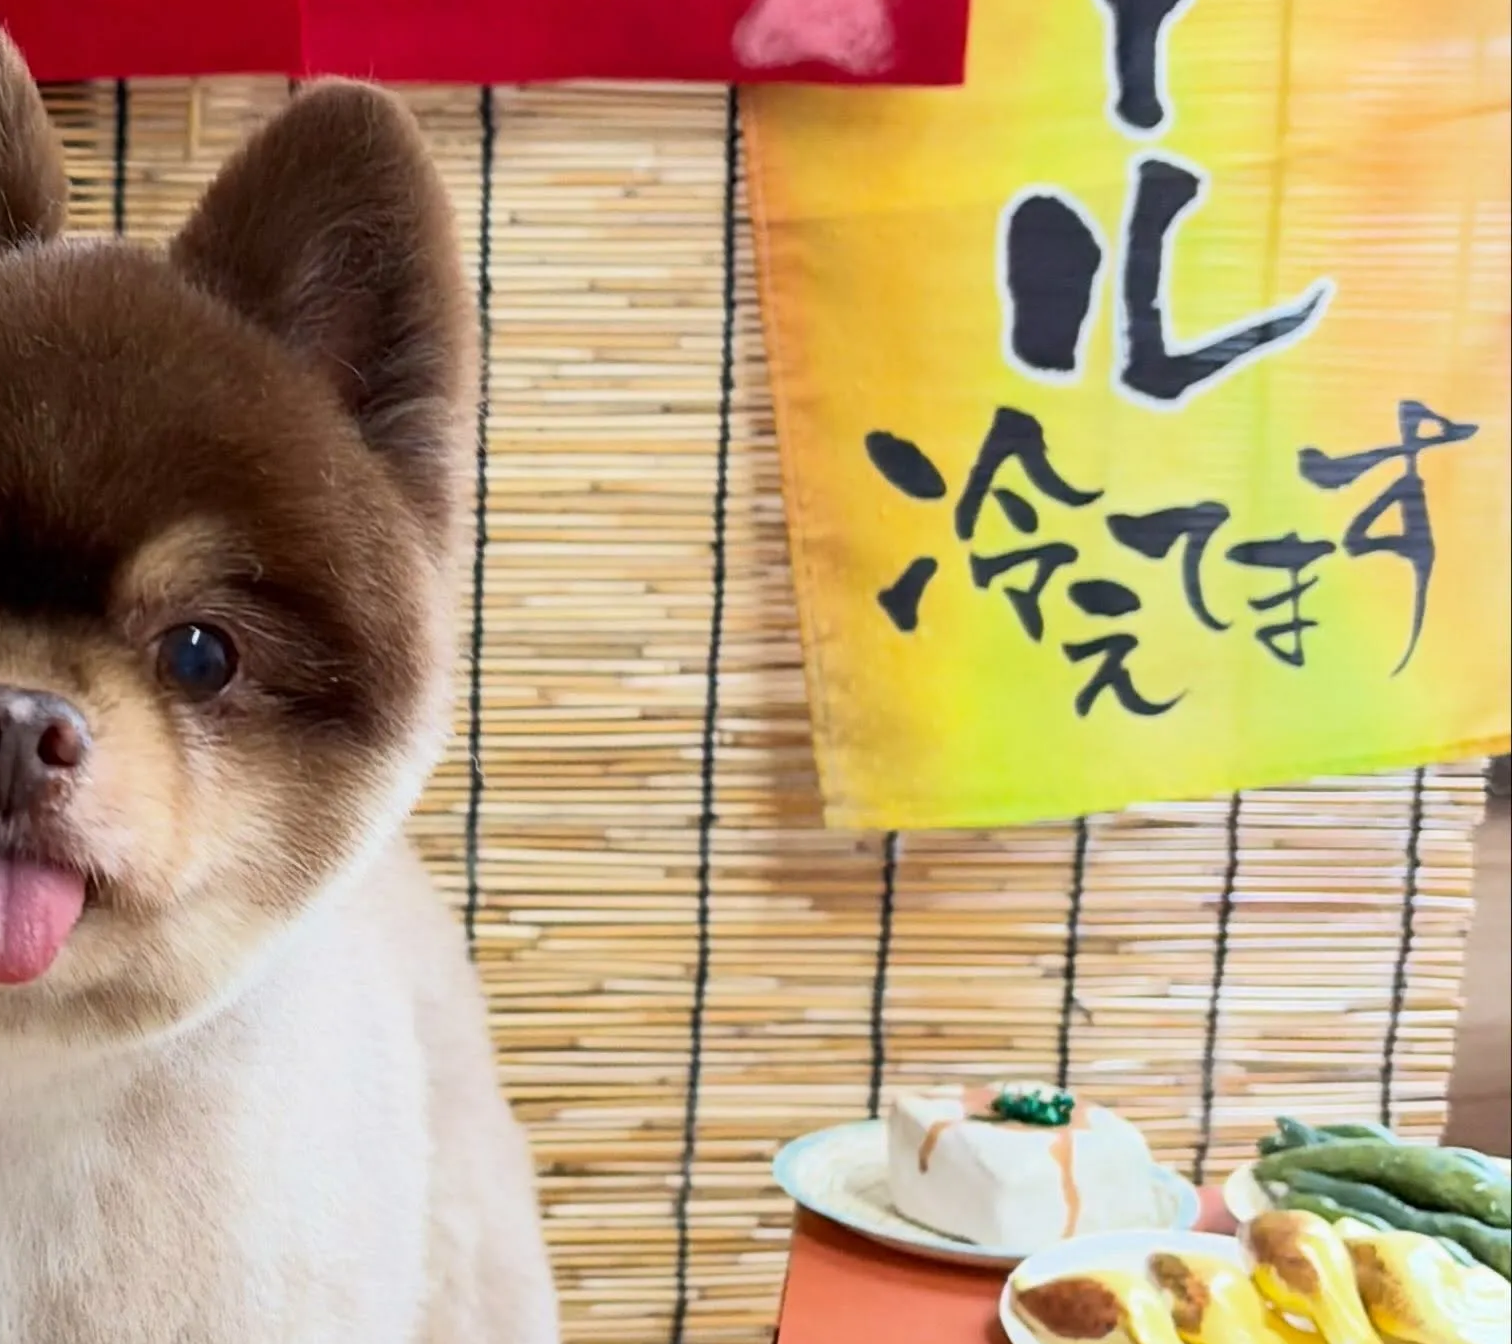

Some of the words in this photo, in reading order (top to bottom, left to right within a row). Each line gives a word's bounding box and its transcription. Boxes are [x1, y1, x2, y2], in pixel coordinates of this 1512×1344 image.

[864, 400, 1480, 716] 冷えてます
